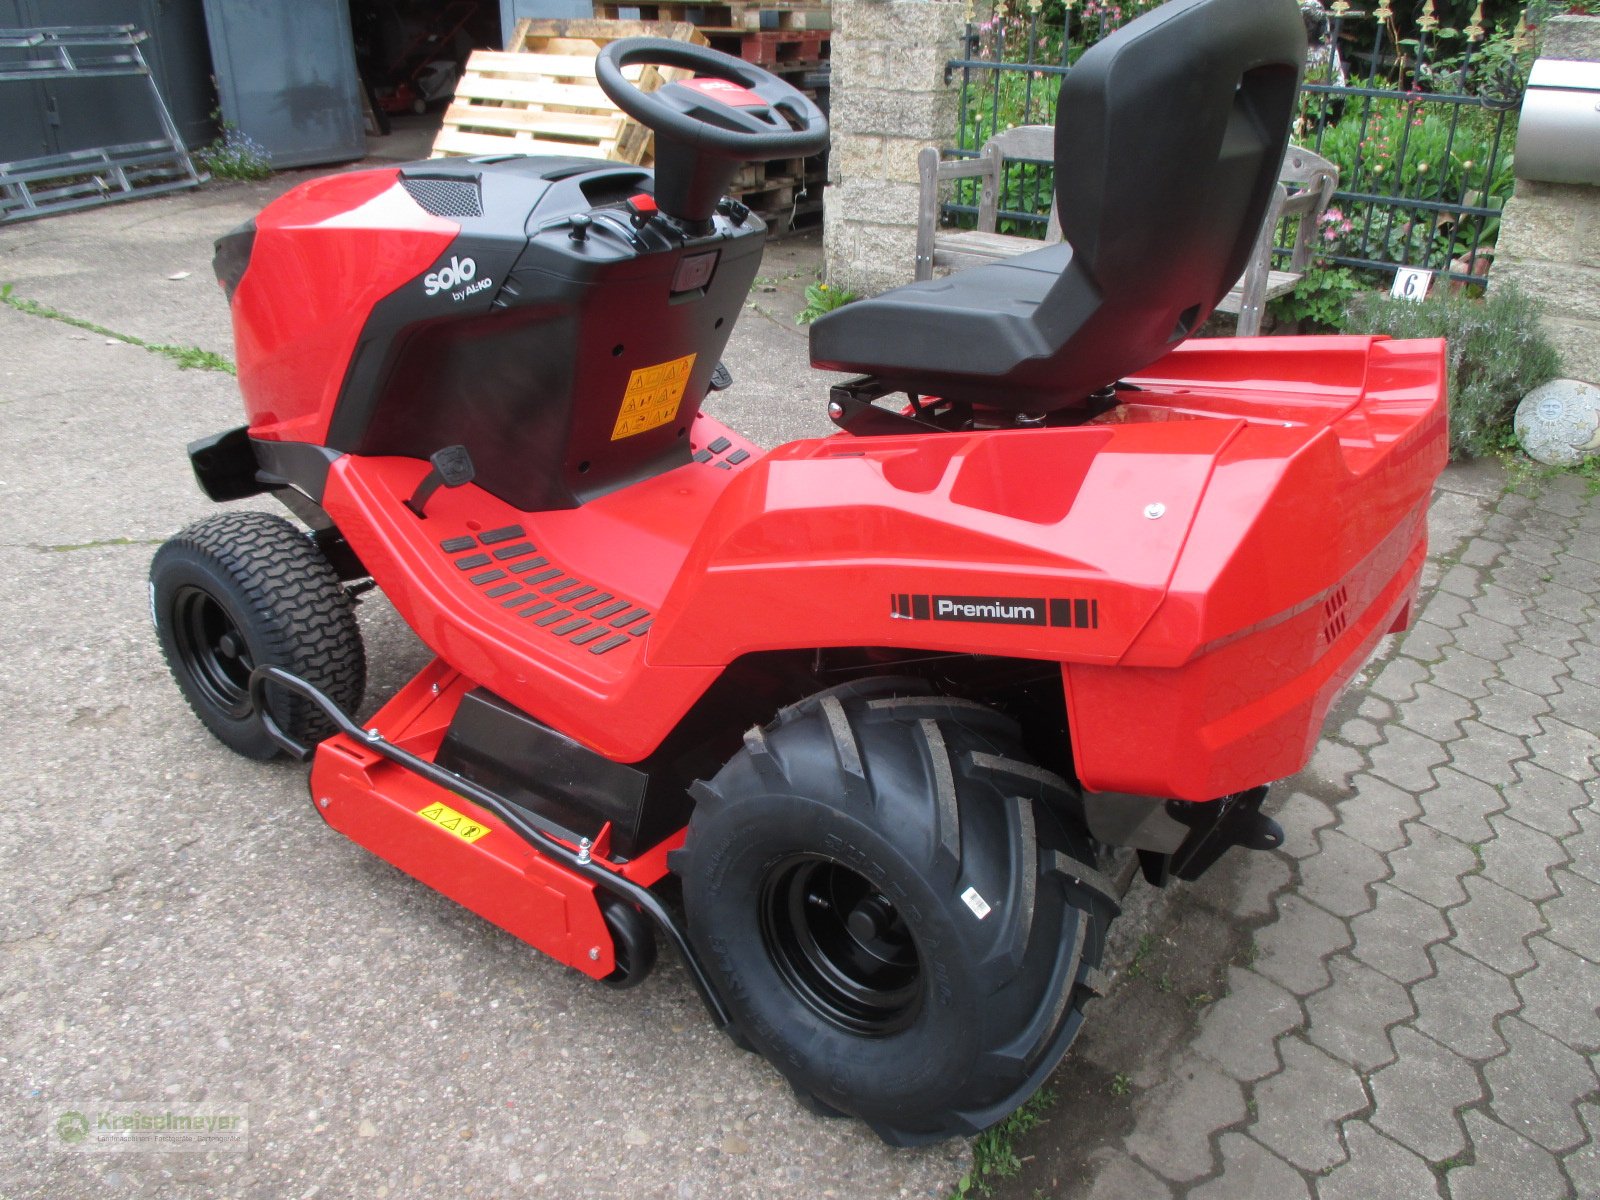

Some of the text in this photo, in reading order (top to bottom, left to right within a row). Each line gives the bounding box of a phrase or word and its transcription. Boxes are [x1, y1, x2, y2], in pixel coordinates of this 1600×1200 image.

[424, 255, 476, 296] solo
[1404, 274, 1418, 296] 6
[452, 278, 492, 300] by AL-KO
[938, 599, 1035, 619] Premium
